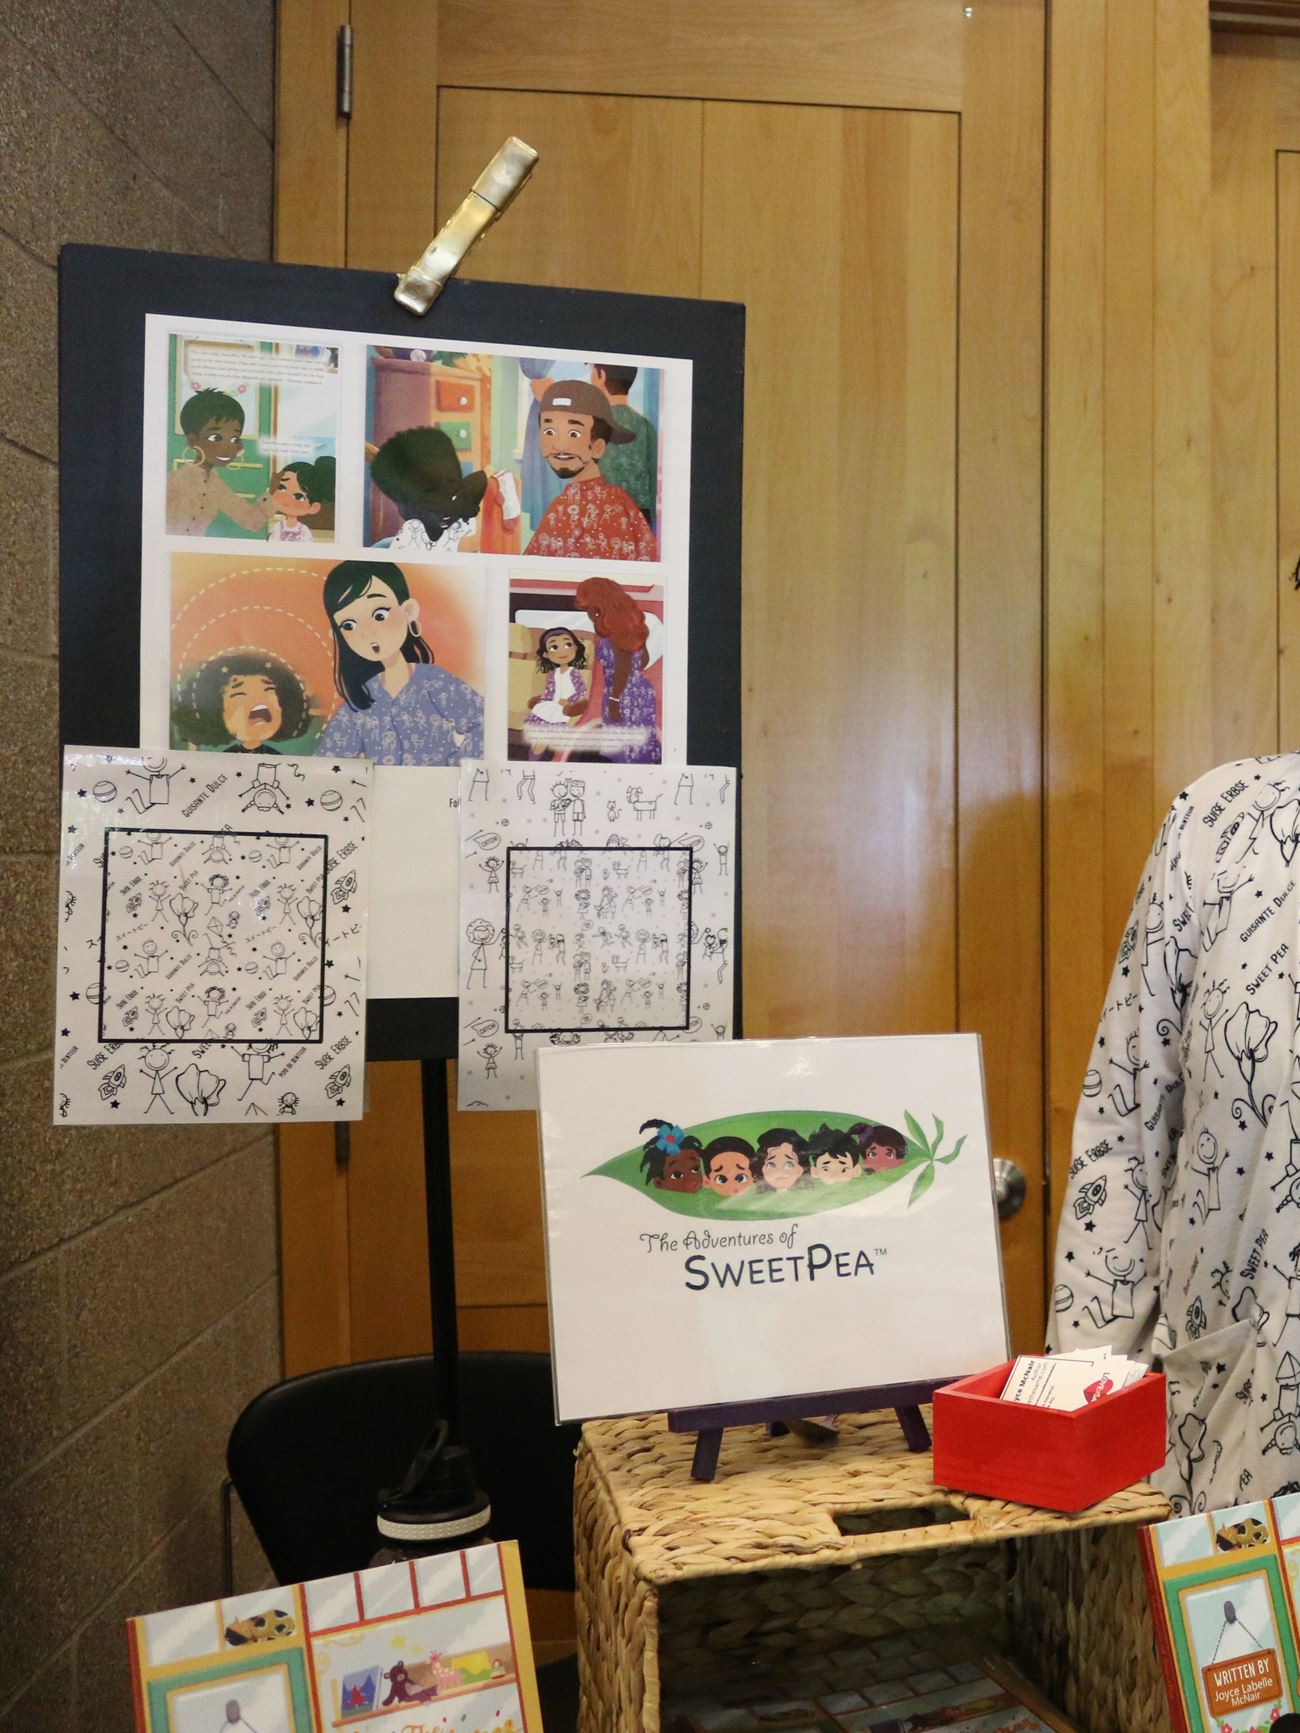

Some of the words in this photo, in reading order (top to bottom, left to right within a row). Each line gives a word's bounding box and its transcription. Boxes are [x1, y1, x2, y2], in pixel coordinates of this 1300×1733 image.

[1239, 906, 1275, 943] GUISANTE
[1272, 880, 1298, 908] DULCE
[1245, 963, 1273, 996] SWEET
[1270, 943, 1290, 964] PEA
[1085, 1139, 1114, 1163] ERBSE
[639, 1232, 679, 1253] The
[682, 1229, 774, 1250] Adventures
[779, 1223, 799, 1249] of
[1240, 1249, 1263, 1280] SWEET
[1019, 1360, 1036, 1387] McNair
[1213, 1662, 1257, 1688] WRITTEN
[1256, 1658, 1271, 1678] BY
[1215, 1688, 1240, 1703] Joyce
[1241, 1677, 1274, 1694] Labelle
[1230, 1691, 1262, 1707] McNair
